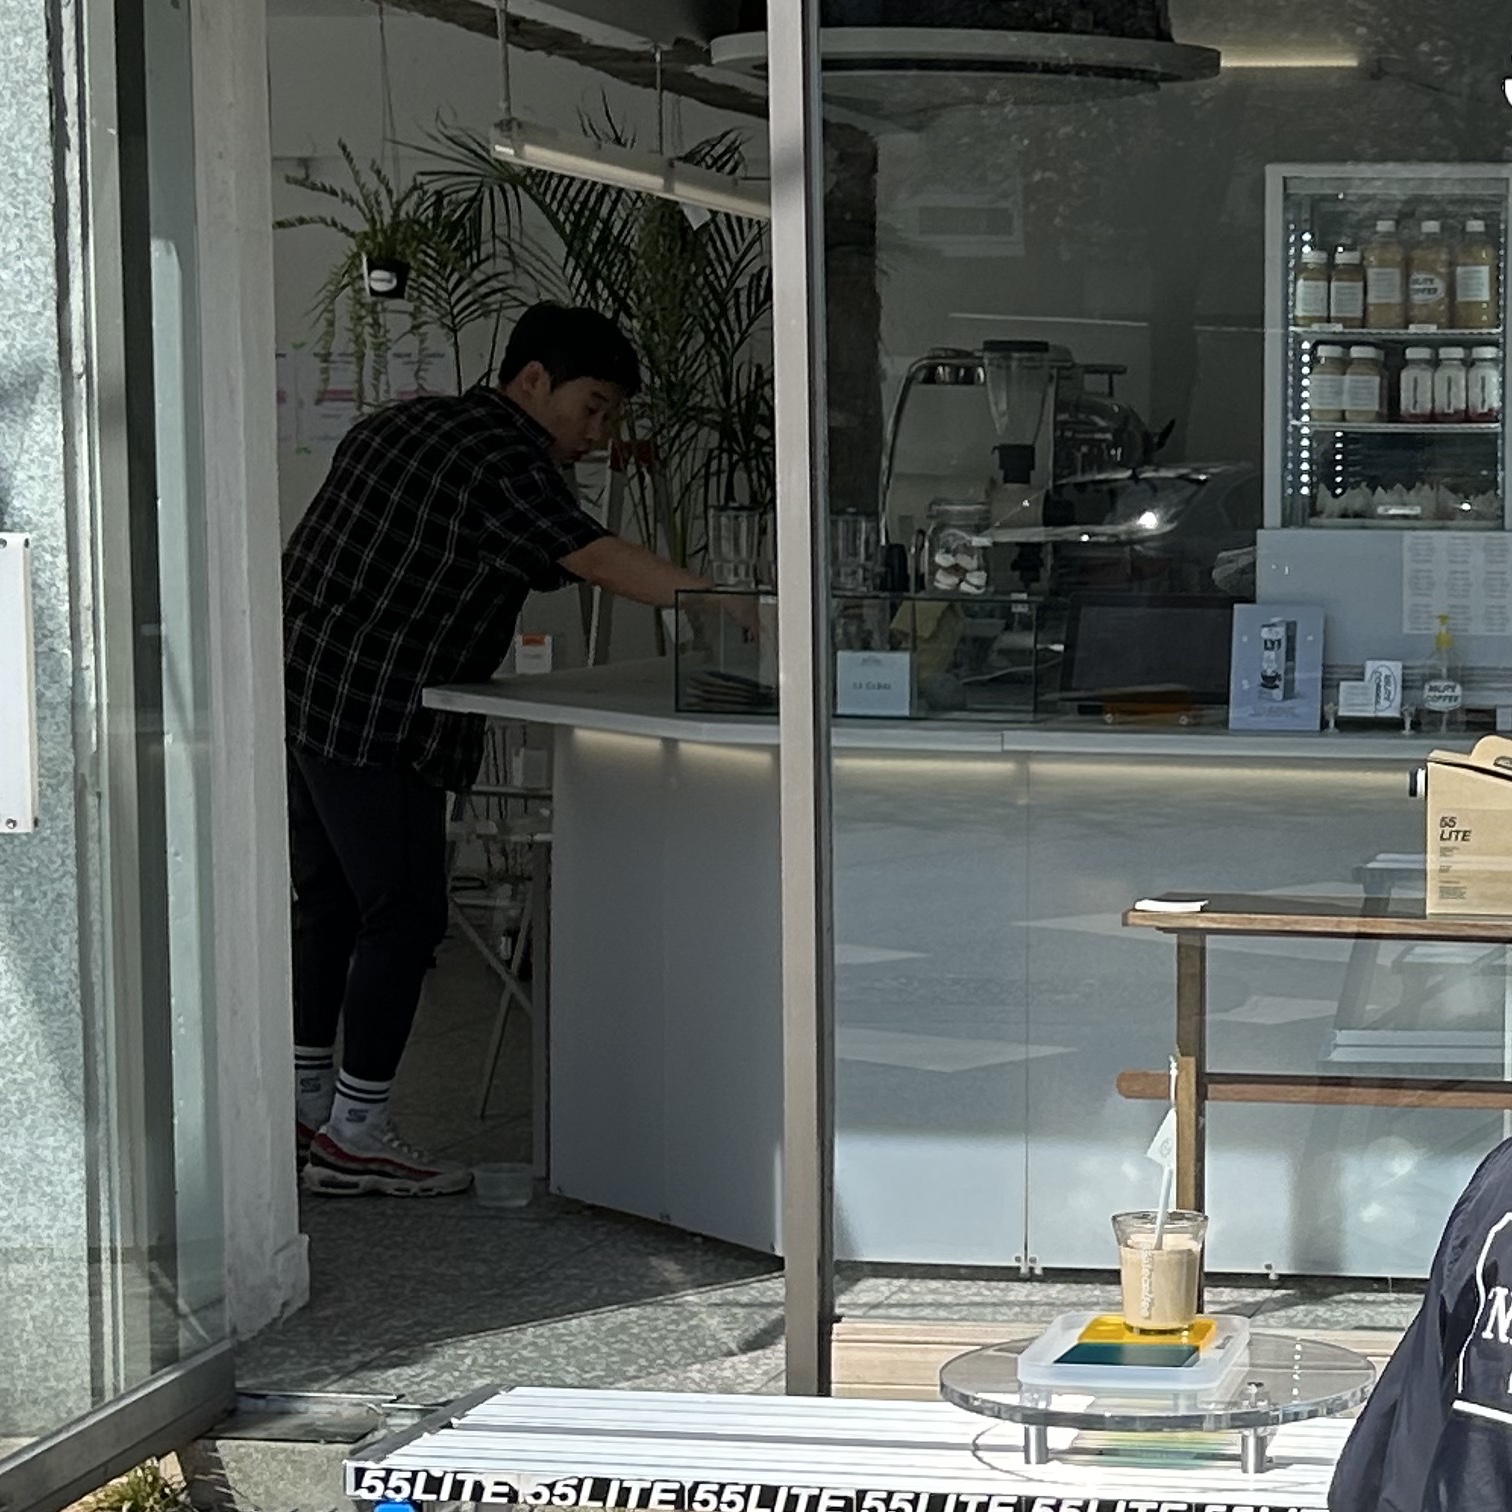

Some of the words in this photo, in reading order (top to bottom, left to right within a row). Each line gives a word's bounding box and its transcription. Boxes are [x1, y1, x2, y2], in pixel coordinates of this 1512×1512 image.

[1440, 816, 1457, 829] 55
[1440, 829, 1472, 842] LITE
[359, 1468, 517, 1503] 55LITE
[523, 1475, 686, 1510] 55LITE
